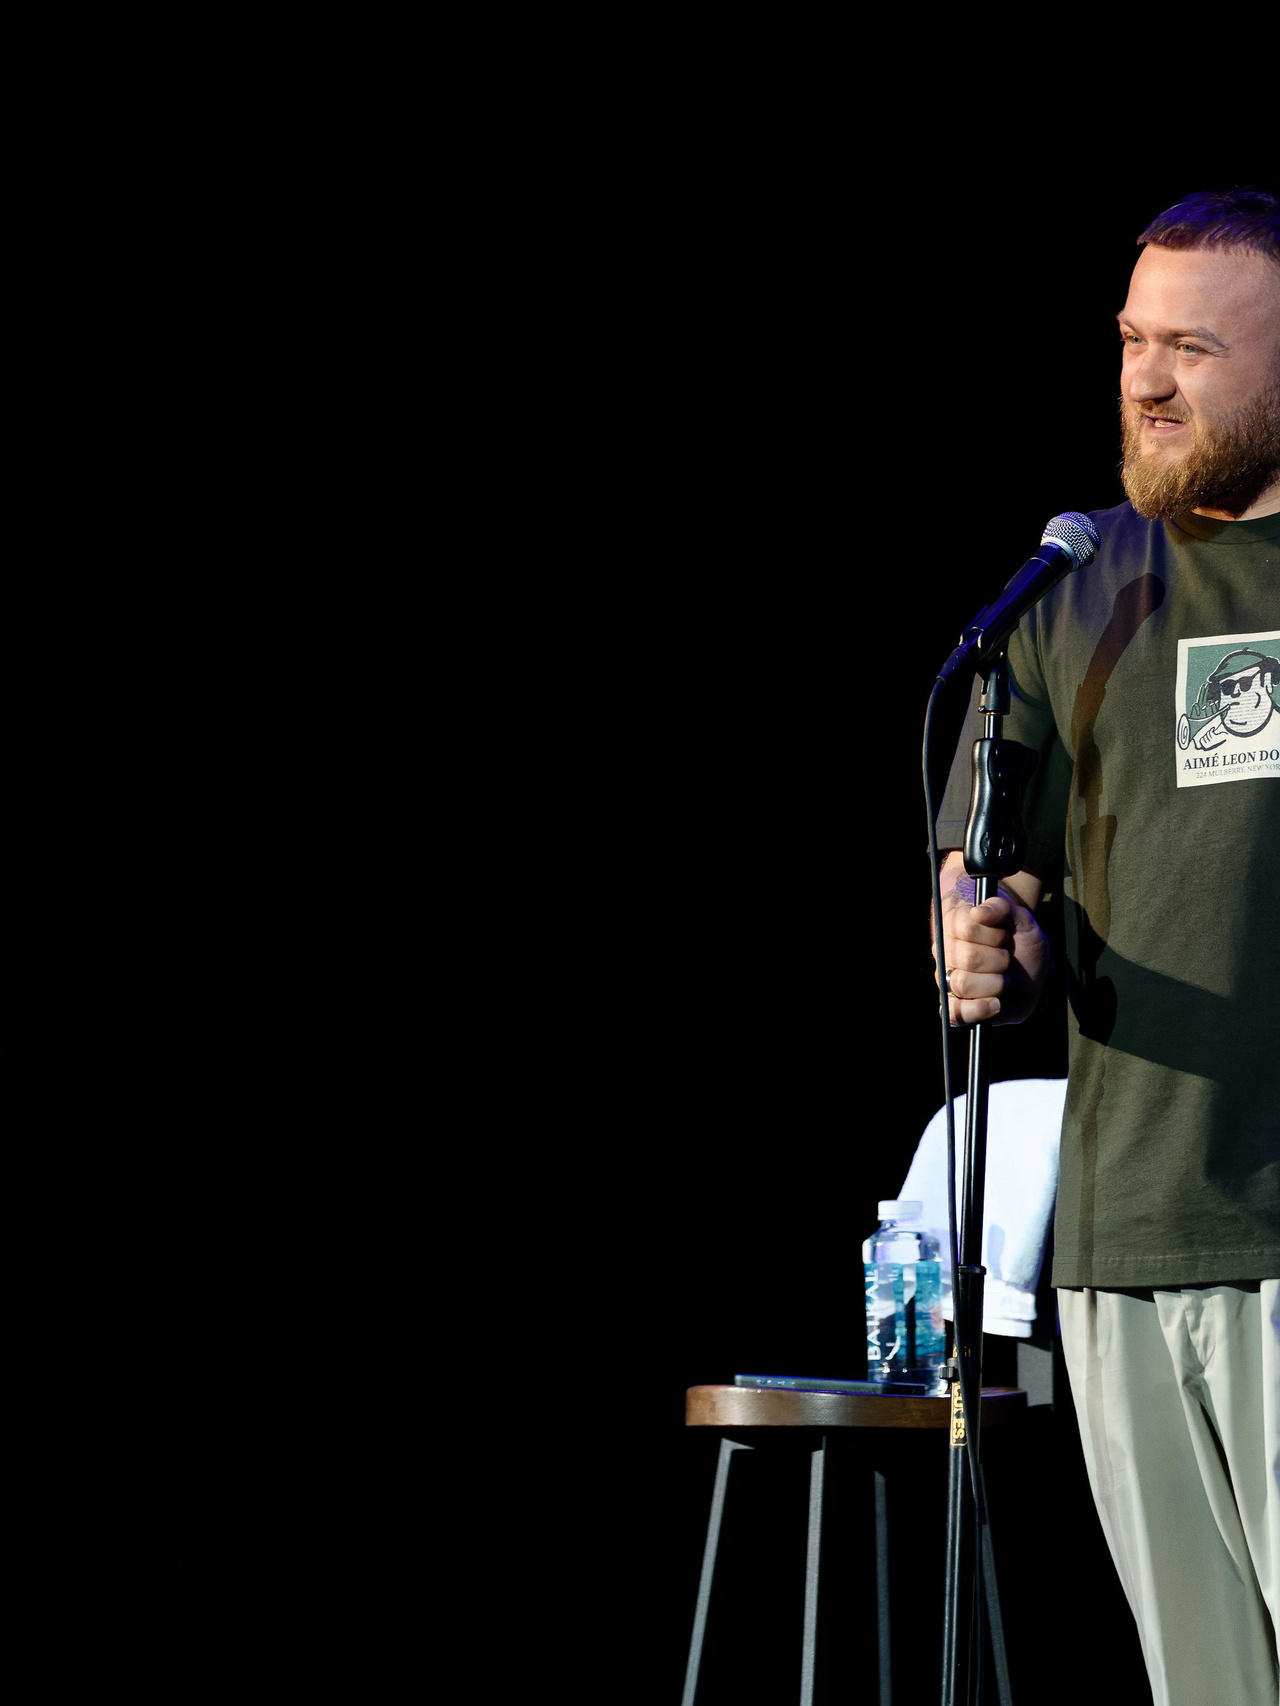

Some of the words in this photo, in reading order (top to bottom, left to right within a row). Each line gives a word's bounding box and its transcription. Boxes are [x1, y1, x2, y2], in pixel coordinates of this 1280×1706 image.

[1183, 753, 1219, 770] AIMÉ
[1222, 751, 1256, 766] LEON
[1247, 765, 1264, 773] NEW
